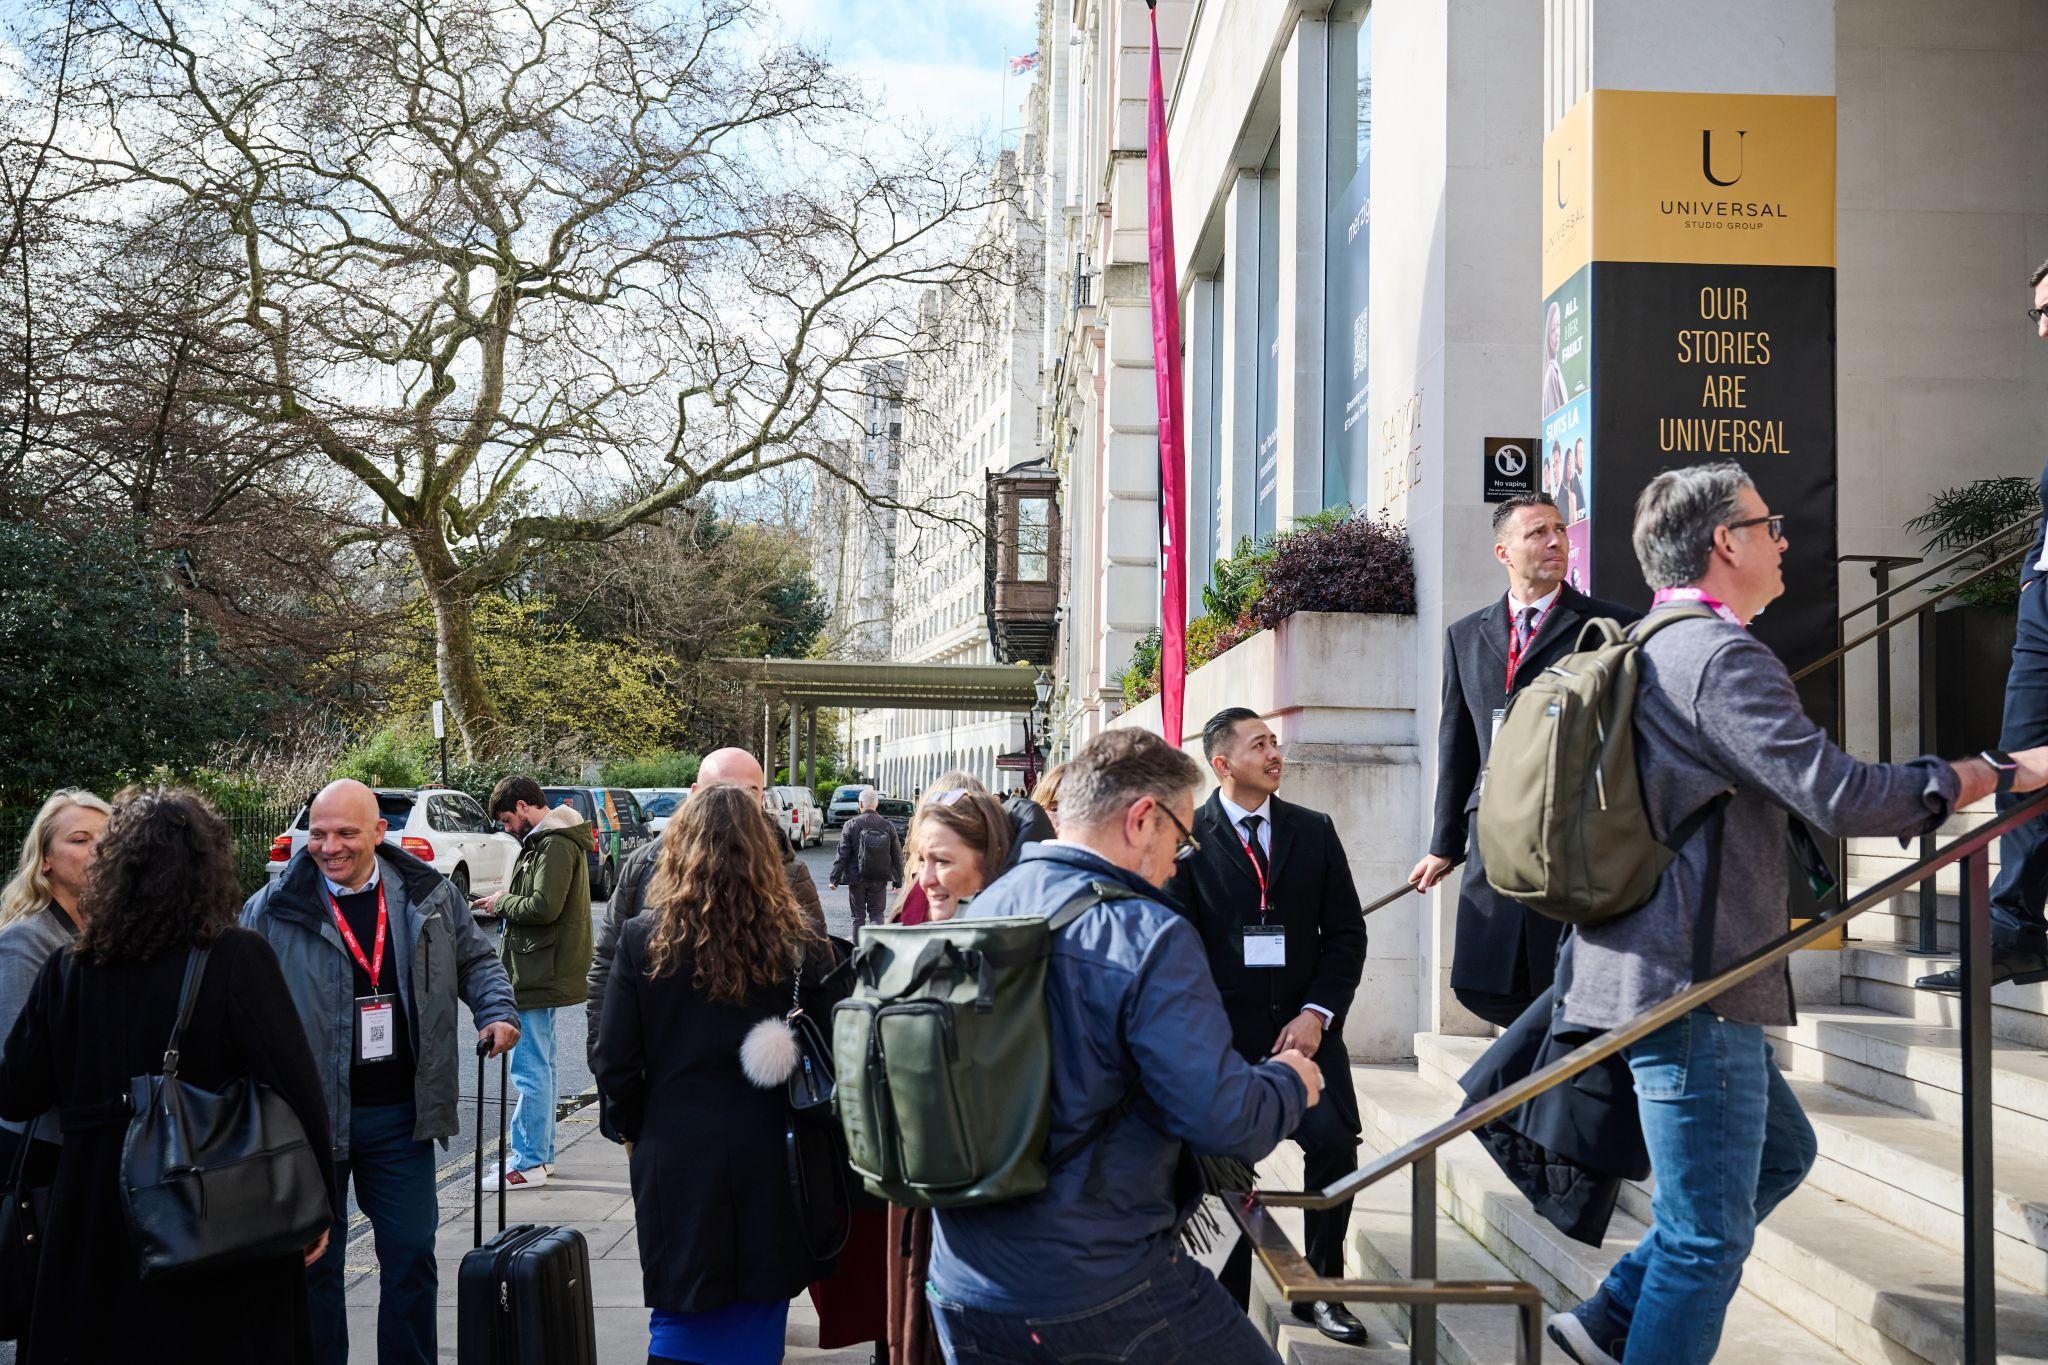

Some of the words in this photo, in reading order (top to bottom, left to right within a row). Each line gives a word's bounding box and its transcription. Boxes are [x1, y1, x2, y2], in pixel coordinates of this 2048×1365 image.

[1661, 201, 1788, 218] UNIVERSAL
[1684, 221, 1723, 230] STUDIO
[1727, 222, 1764, 230] GROUP
[1564, 297, 1579, 319] ALL
[1700, 286, 1747, 321] OUR
[1564, 318, 1579, 341] HER
[1561, 335, 1583, 363] FAULT
[1677, 329, 1771, 365] STORIES
[1702, 375, 1747, 409] ARE
[1382, 387, 1424, 456] SAVOY
[1545, 413, 1567, 443] SUITS
[1567, 406, 1580, 430] LA
[1660, 418, 1790, 454] UNIVERSAL
[1383, 445, 1422, 508] PLACE
[1505, 480, 1527, 488] vaping
[620, 838, 628, 851] The
